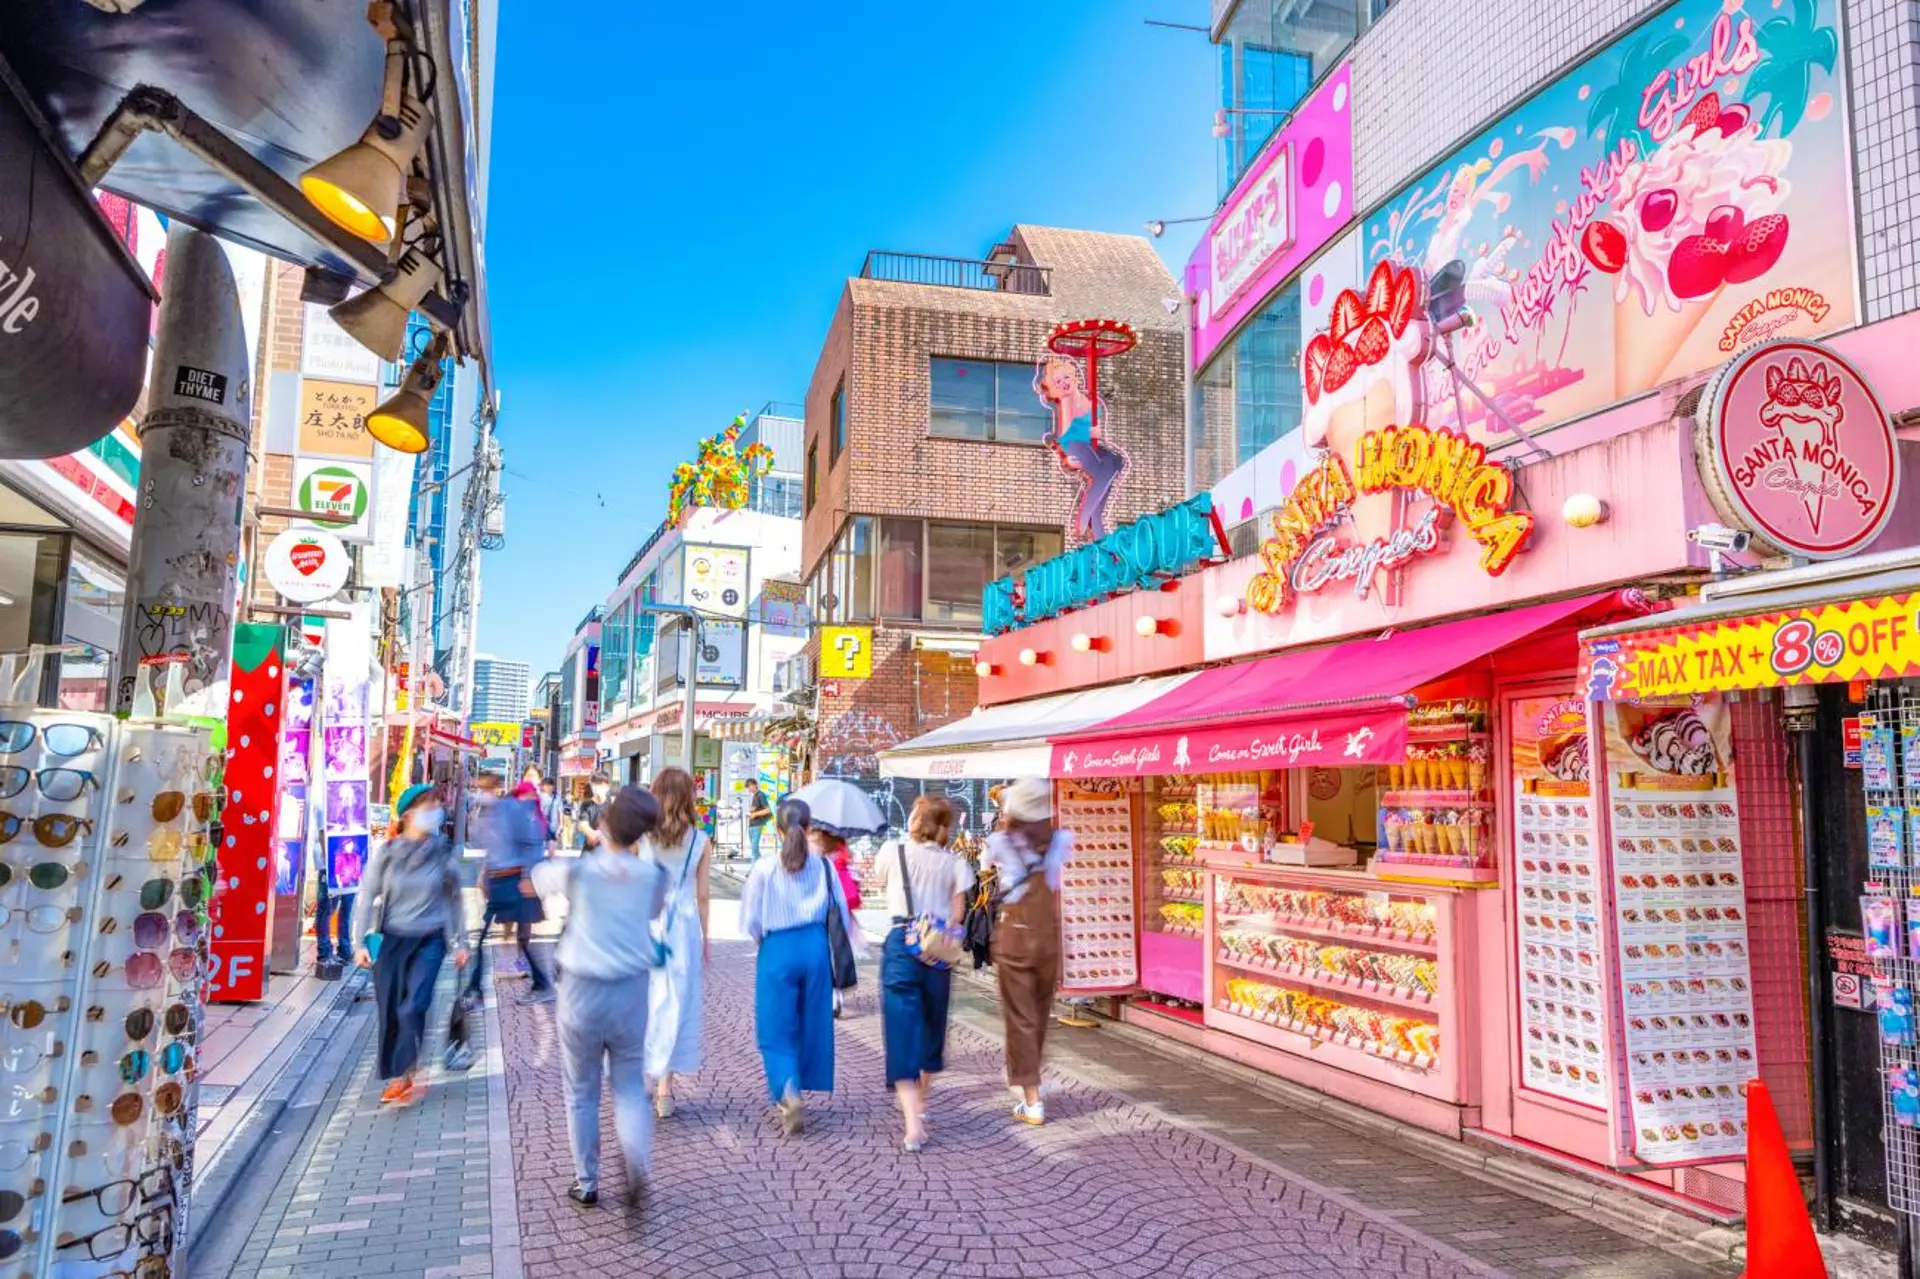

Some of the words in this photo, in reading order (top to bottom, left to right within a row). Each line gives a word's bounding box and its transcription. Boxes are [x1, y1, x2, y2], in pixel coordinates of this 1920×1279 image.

[1637, 13, 1761, 141] Girls
[1719, 298, 1765, 351] SANTA
[1767, 288, 1830, 323] MONICA
[179, 381, 222, 401] THYME
[187, 369, 217, 387] DIET
[315, 391, 366, 405] とんかつ
[304, 409, 366, 433] 庄太郎
[1735, 435, 1798, 488] SANTA
[1803, 440, 1876, 517] MONICA
[1246, 452, 1357, 617] SANTA
[1353, 424, 1535, 577] MONICA
[1638, 653, 1688, 688] MAX
[1848, 614, 1908, 657] OFF
[206, 953, 255, 992] 2F
